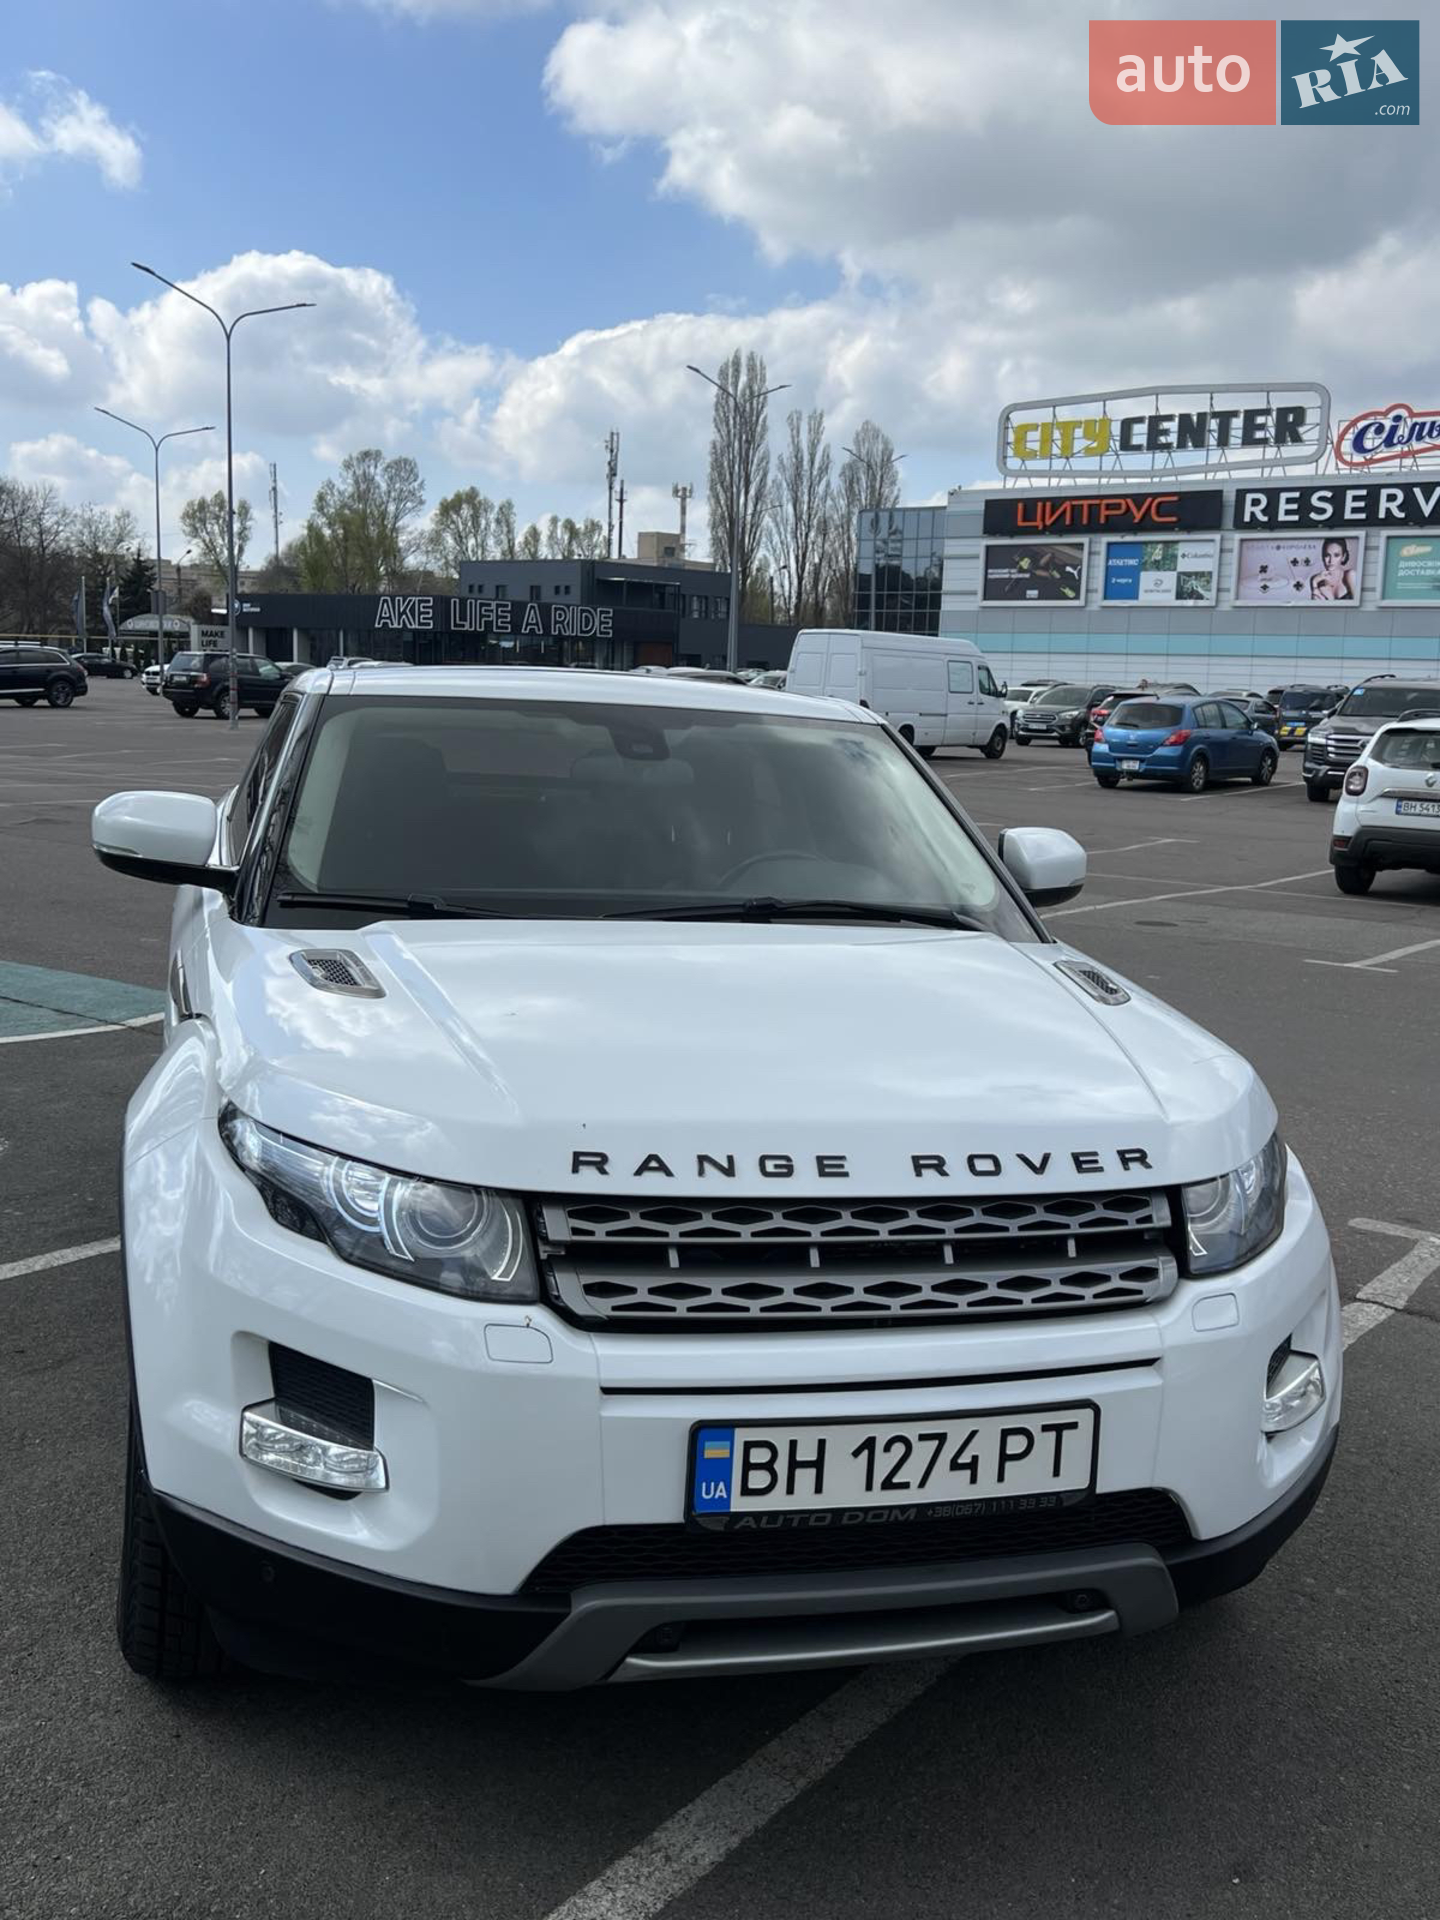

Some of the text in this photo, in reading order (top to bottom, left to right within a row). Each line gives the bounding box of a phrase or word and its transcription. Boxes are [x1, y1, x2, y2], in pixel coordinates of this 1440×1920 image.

[1013, 406, 1306, 461] CITY CENTER
[1016, 496, 1179, 528] ЦИТРУС
[1243, 487, 1440, 522] RESERV
[451, 598, 512, 633] LIFE
[521, 603, 543, 634] A
[551, 604, 614, 638] RIDE
[201, 630, 225, 638] MAKE
[201, 640, 218, 648] LIFE
[1403, 802, 1417, 811] BH
[571, 1147, 1153, 1178] RANGE ROVER
[740, 1421, 1079, 1497] BH 1274 PT
[702, 1481, 728, 1499] UA
[733, 1511, 833, 1530] AUTO
[840, 1507, 917, 1527] DOM
